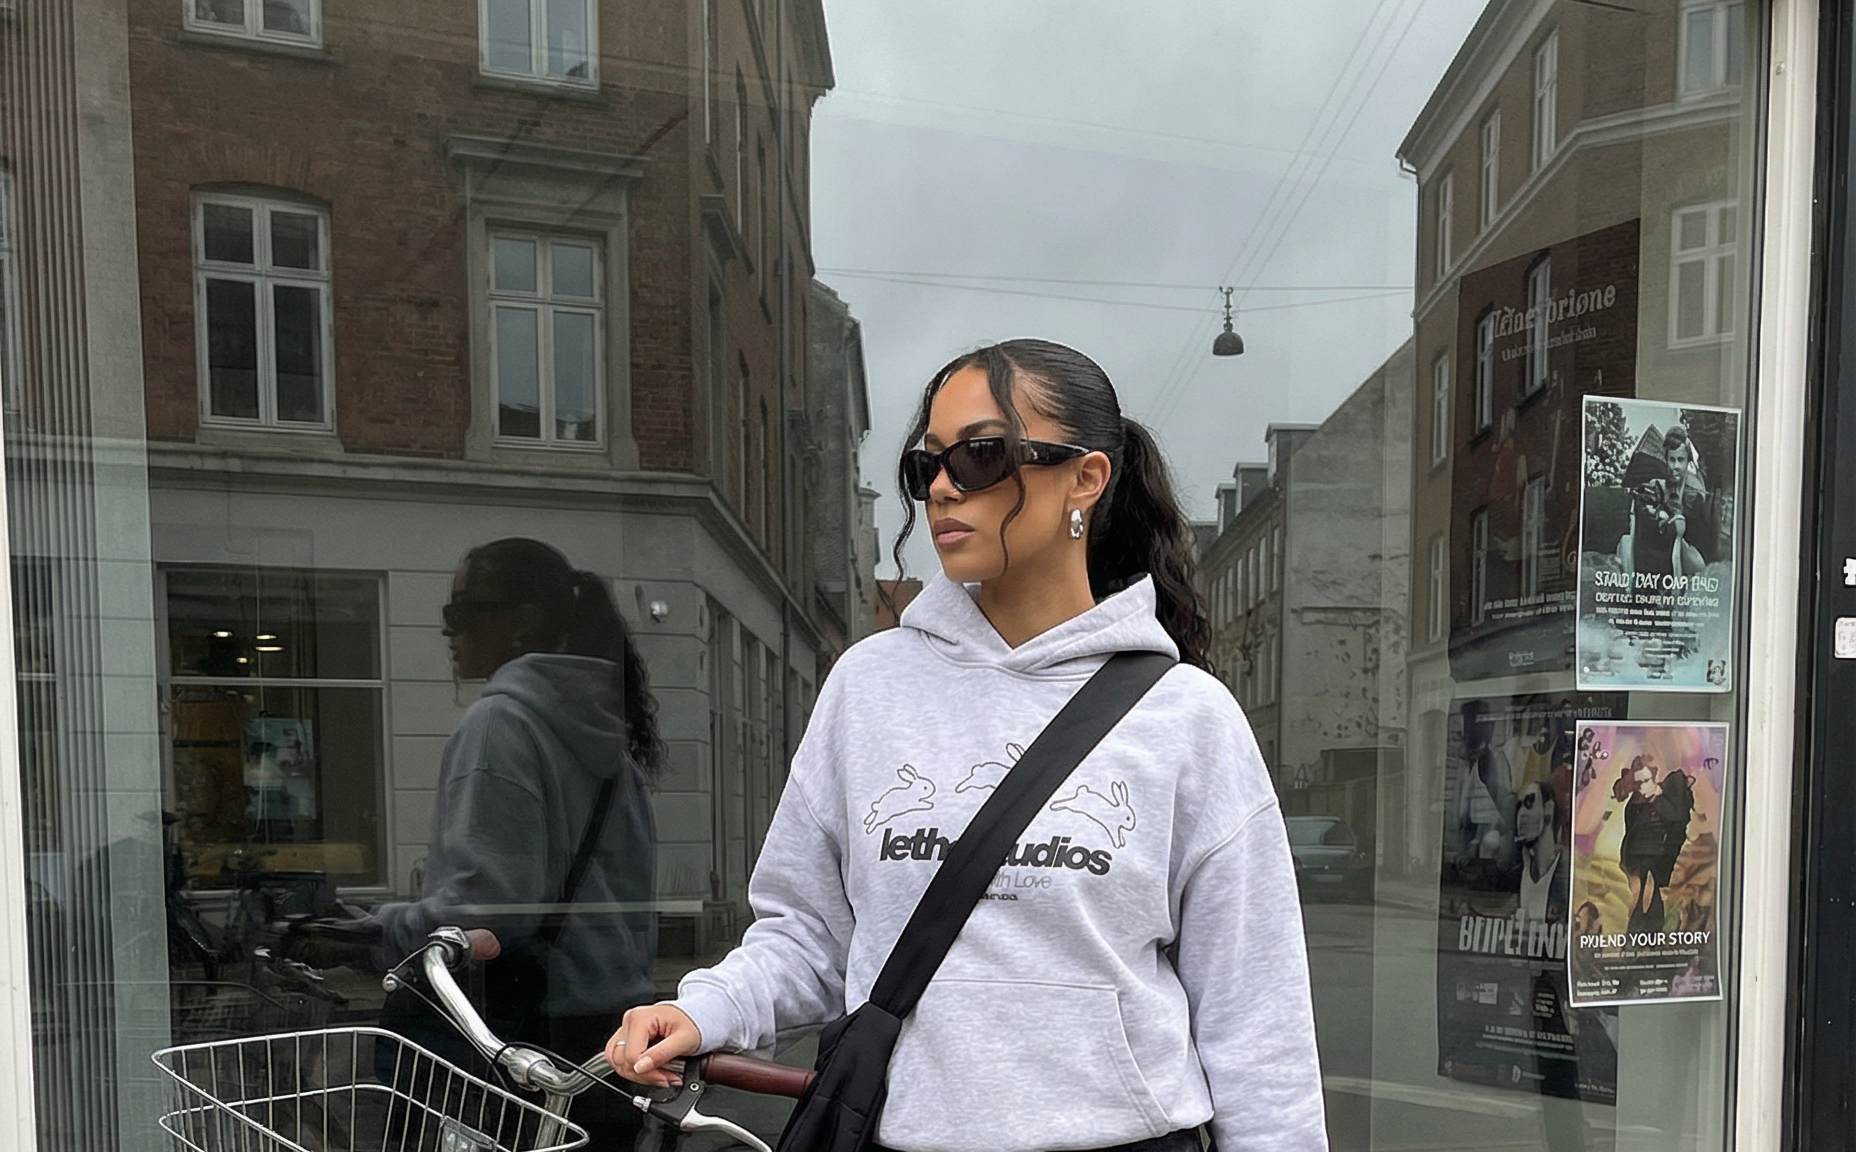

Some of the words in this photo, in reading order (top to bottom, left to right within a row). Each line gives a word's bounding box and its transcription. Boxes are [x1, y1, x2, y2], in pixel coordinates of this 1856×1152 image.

[880, 827, 959, 862] leth
[1014, 871, 1053, 889] Love
[1629, 932, 1666, 947] YOUR
[1668, 930, 1711, 945] STORY
